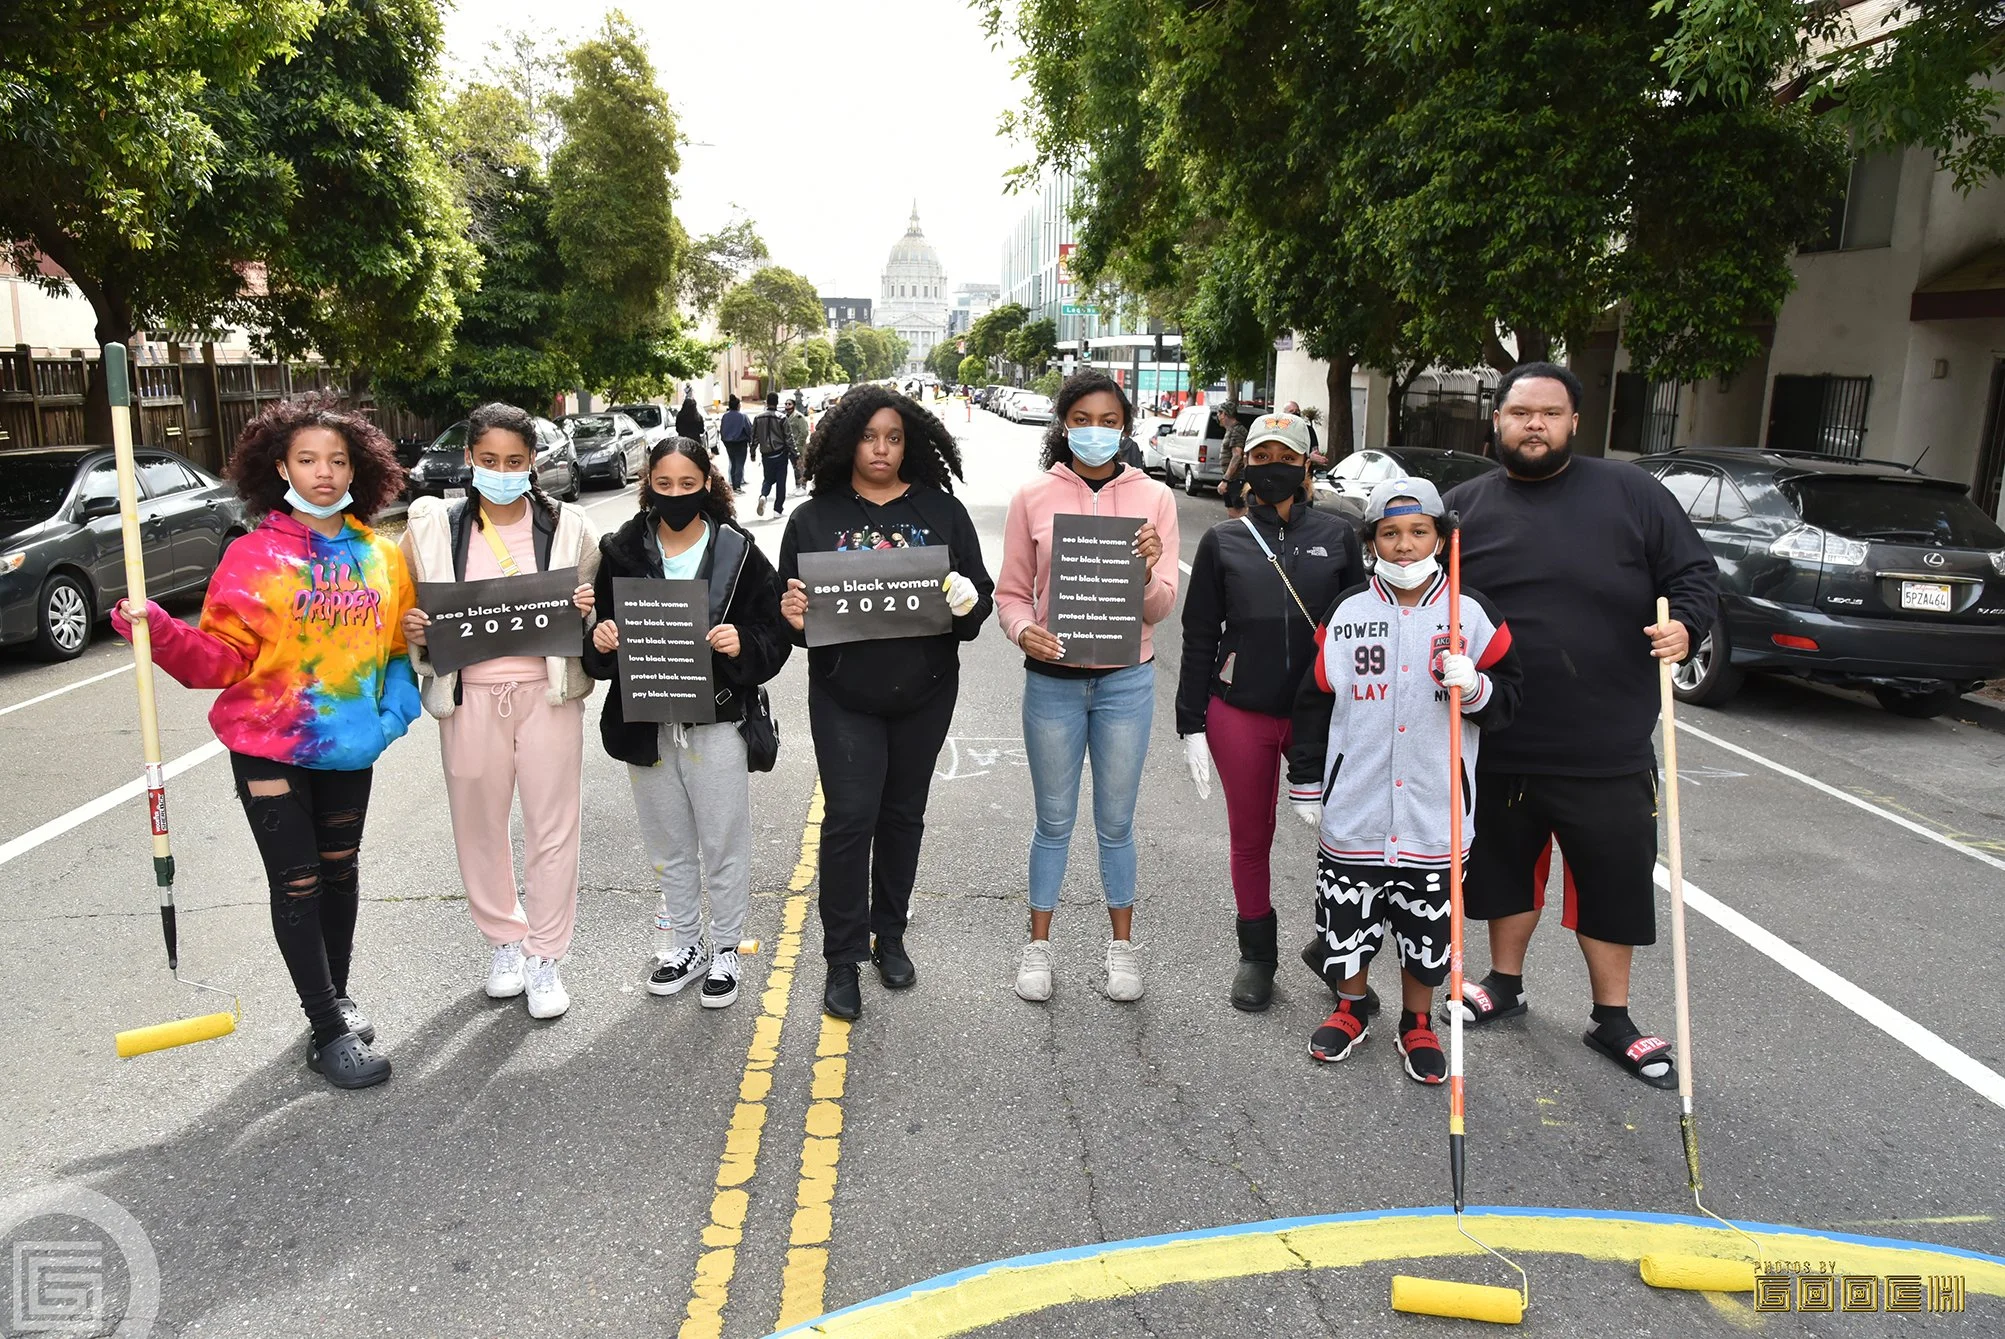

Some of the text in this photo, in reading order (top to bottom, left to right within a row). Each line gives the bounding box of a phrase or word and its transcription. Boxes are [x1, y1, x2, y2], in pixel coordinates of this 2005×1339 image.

[1076, 535, 1099, 545] black
[1060, 553, 1131, 566] hear black women
[1059, 574, 1130, 585] trust black women
[813, 579, 938, 594] see black women
[1058, 592, 1075, 601] love
[1075, 593, 1098, 602] black
[1905, 591, 1946, 606] 5PZA464
[638, 599, 661, 608] black
[435, 600, 568, 620] see black women
[1057, 612, 1086, 621] protect
[1085, 612, 1108, 621] black
[624, 617, 643, 626] hear
[643, 618, 665, 627] black
[1056, 632, 1073, 641] pay
[1072, 631, 1095, 639] black
[1334, 622, 1389, 641] POWER
[645, 636, 667, 645] black
[628, 654, 645, 662] love
[644, 654, 667, 663] black
[1355, 645, 1386, 675] 99
[630, 673, 658, 681] protect
[657, 672, 680, 681] black
[647, 690, 669, 698] black
[1351, 684, 1388, 700] LAY
[1435, 690, 1451, 702] NY
